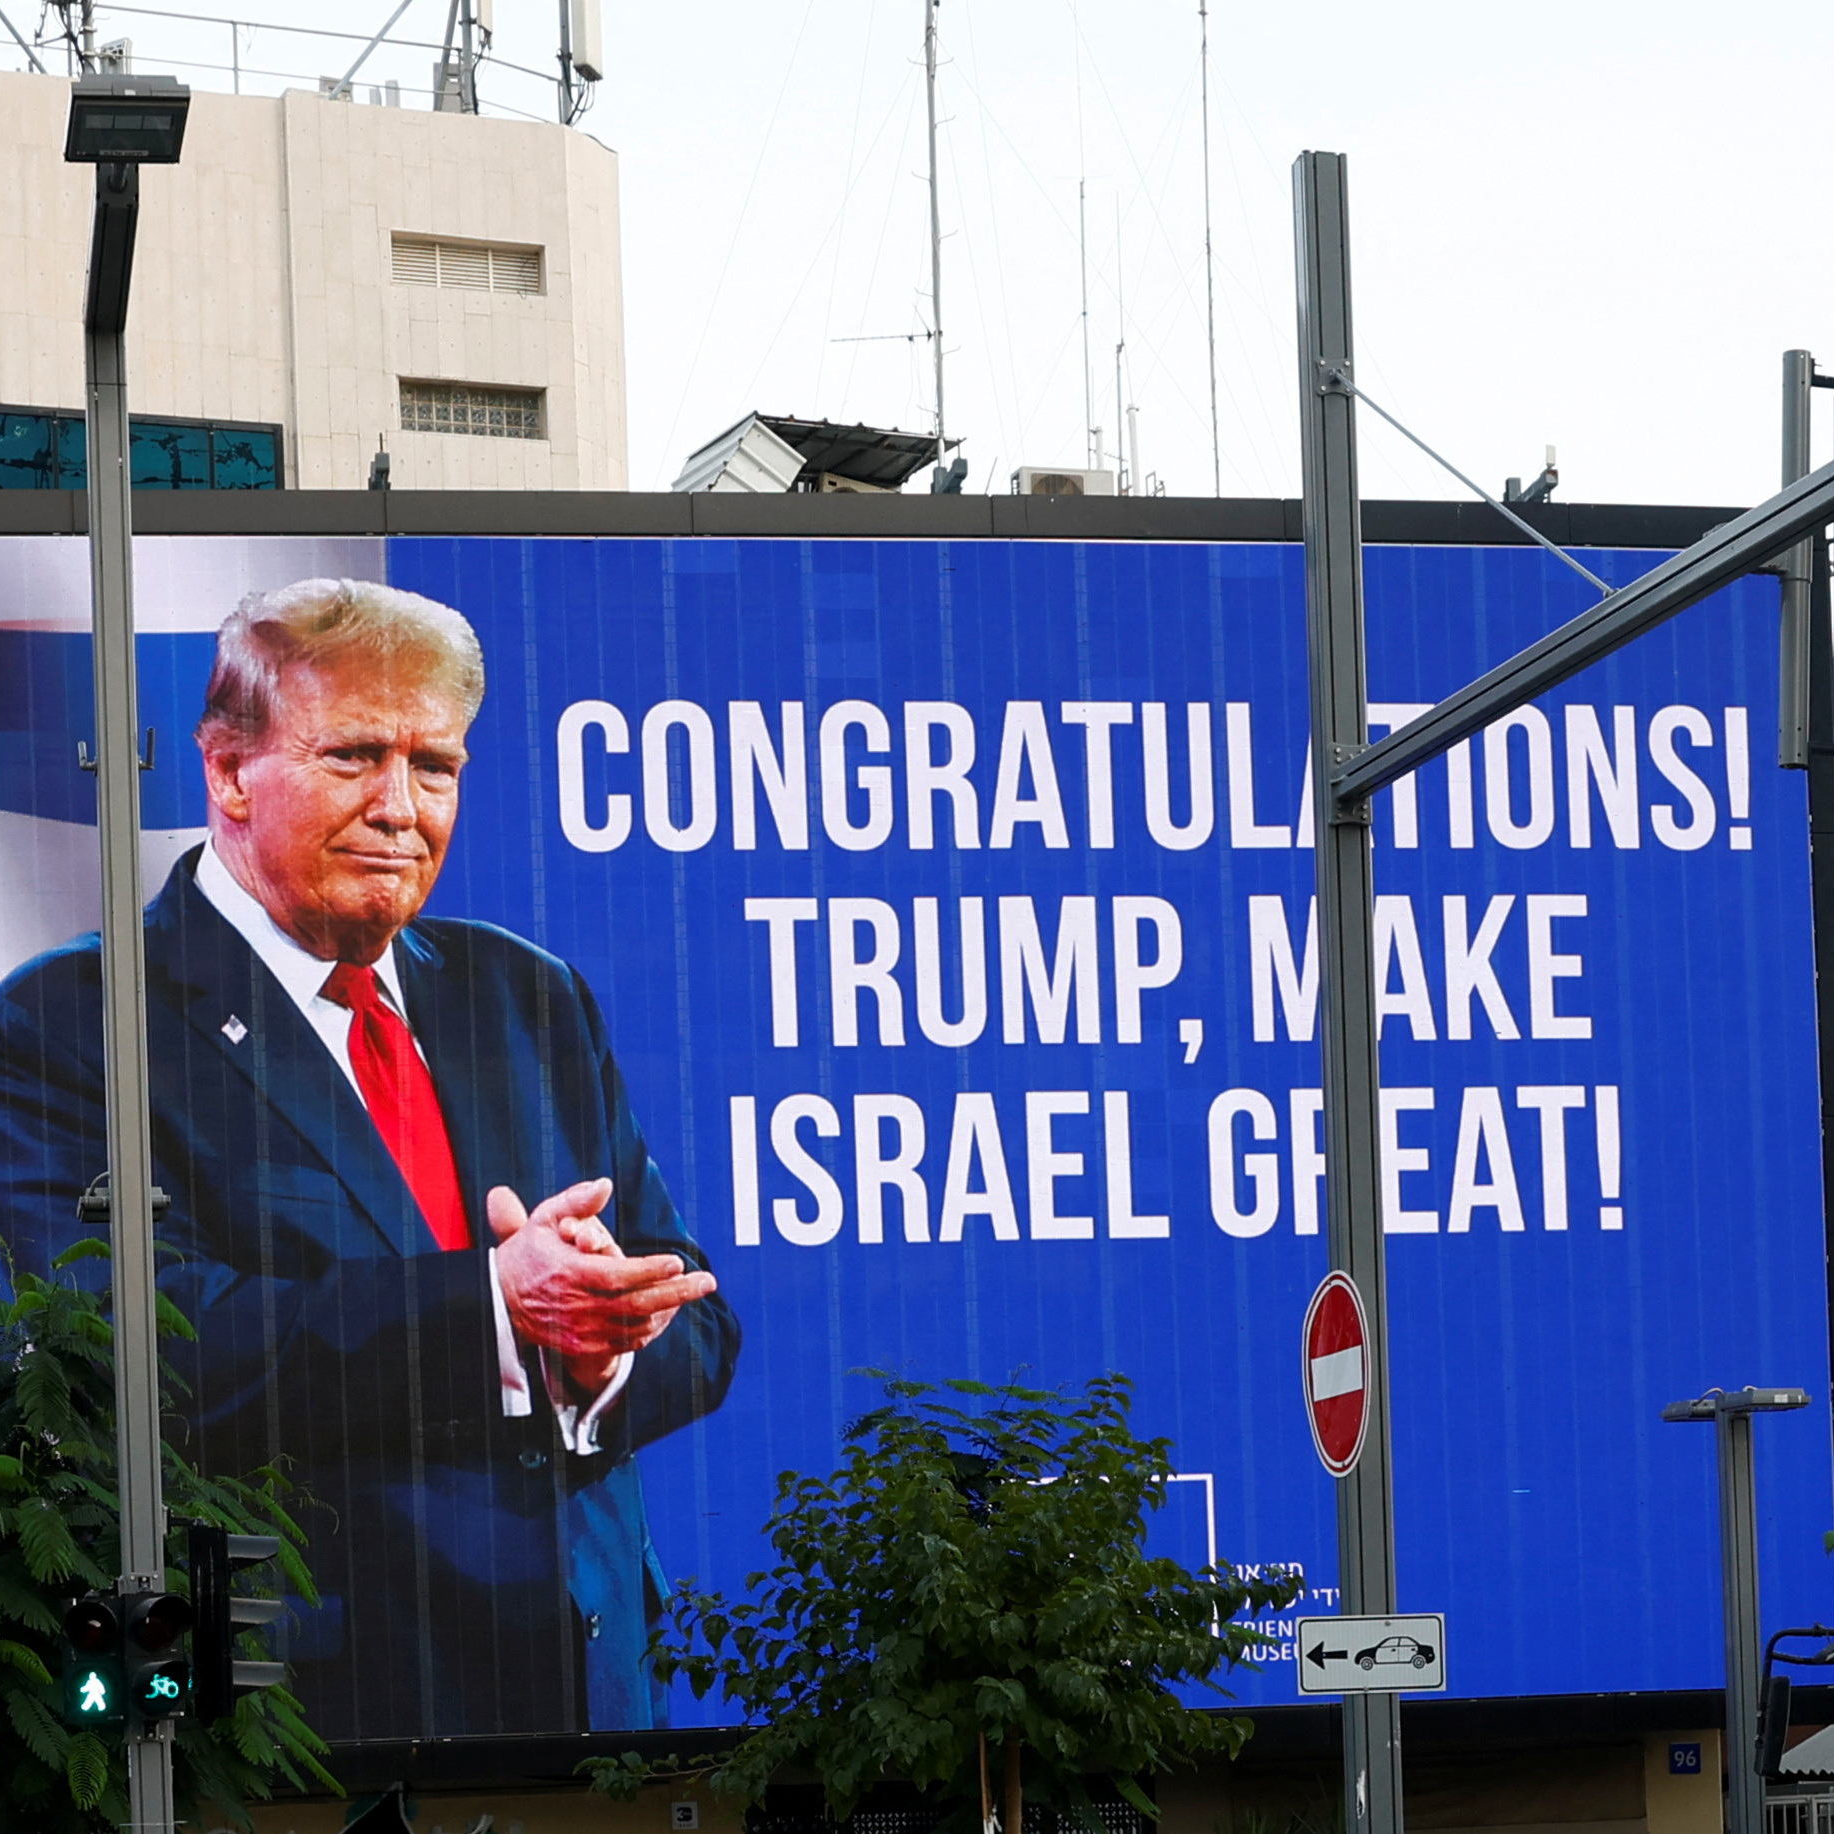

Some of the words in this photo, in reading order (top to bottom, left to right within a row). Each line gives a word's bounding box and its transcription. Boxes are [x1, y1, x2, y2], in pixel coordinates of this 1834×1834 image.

[745, 896, 1204, 1064] TRUMP,
[1248, 894, 1593, 1042] MAKE
[730, 1090, 1169, 1246] ISRAEL
[1674, 1750, 1696, 1767] 96
